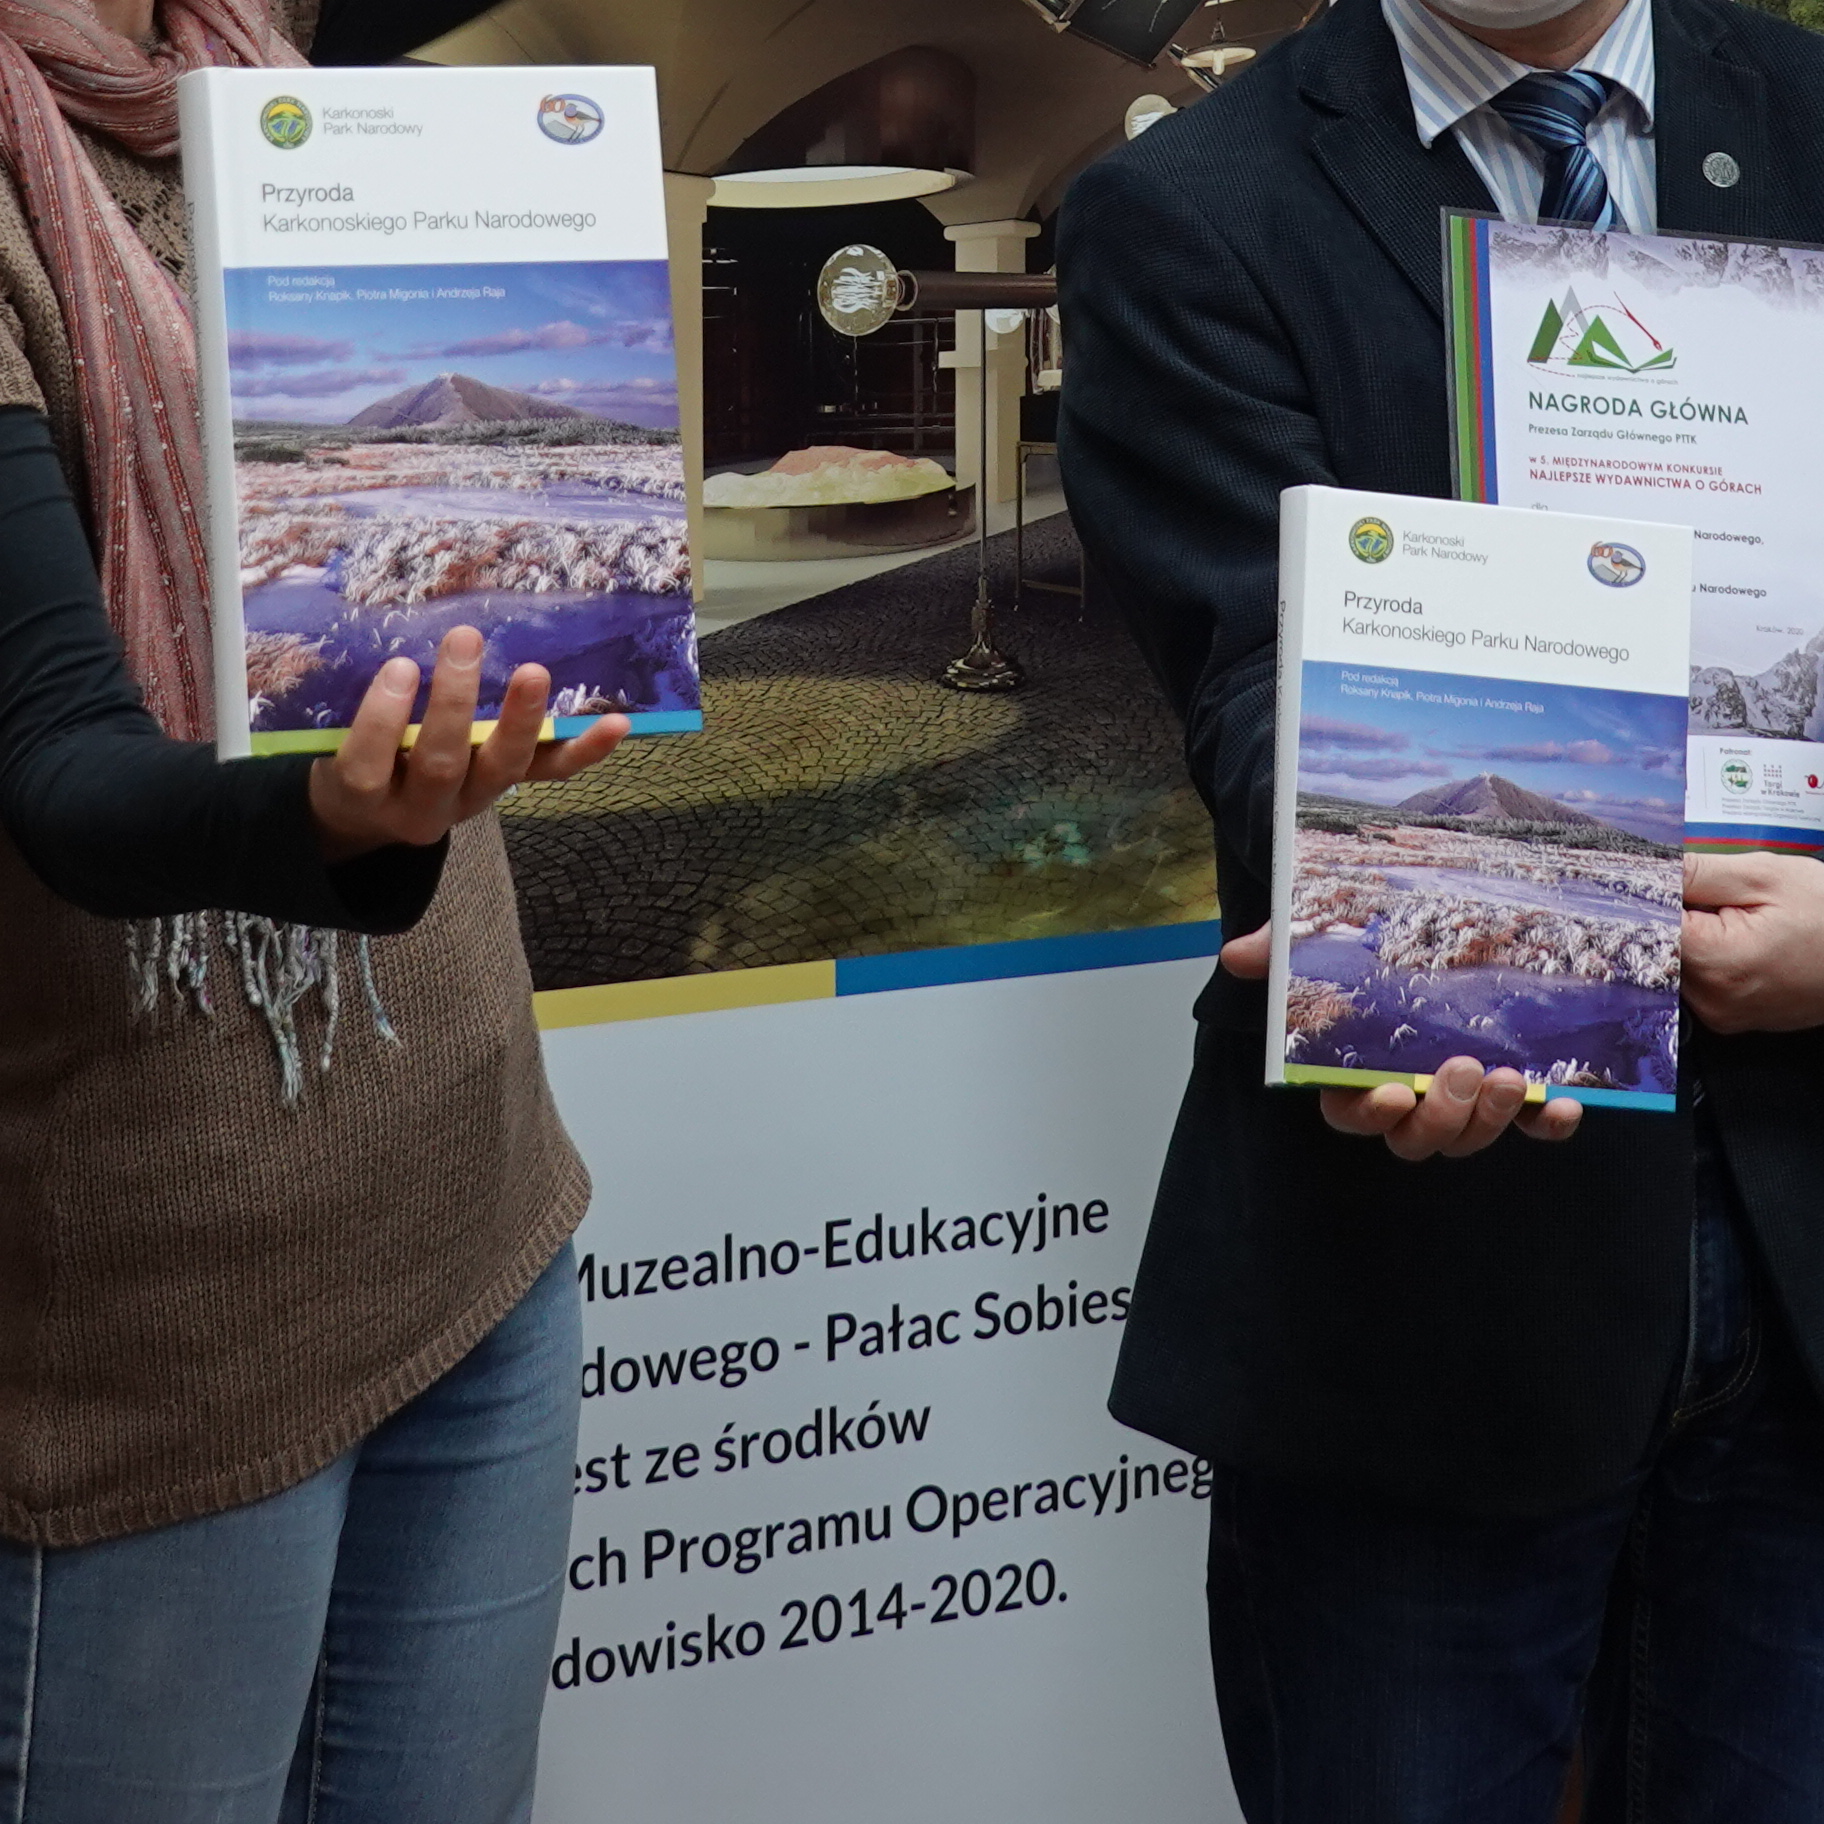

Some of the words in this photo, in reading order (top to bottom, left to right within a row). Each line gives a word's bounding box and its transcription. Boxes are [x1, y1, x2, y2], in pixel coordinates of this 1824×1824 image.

[323, 107, 394, 119] Karkonoski
[324, 122, 353, 135] Park
[357, 122, 423, 137] Narodowy
[262, 183, 354, 207] Przyroda
[264, 213, 407, 235] Karkonoskiego
[414, 211, 468, 230] Parku
[475, 210, 596, 232] Narodowego
[267, 276, 289, 286] Pod
[1529, 391, 1642, 417] NAGRODA
[1650, 397, 1748, 425] GŁÓWNA
[1529, 424, 1568, 436] Prezesa
[1571, 427, 1613, 440] Zarządu
[1617, 430, 1672, 444] Głównego
[1676, 434, 1696, 444] PTTK
[1553, 457, 1663, 471] MIĘDZYNARODOWYM
[1667, 464, 1722, 476] KONKURSIE
[1530, 469, 1591, 483] NAJLEPSZE
[1595, 474, 1691, 489] WYDAWNICTWA
[1695, 480, 1705, 490] O
[1709, 479, 1761, 494] GÓRACH
[1403, 530, 1464, 547] Karkonoski
[1694, 530, 1764, 545] Narodowego,
[1403, 544, 1427, 556] Park
[1431, 547, 1488, 565] Narodowy
[1700, 583, 1767, 599] Narodowego
[1344, 591, 1423, 615] Przyroda
[1343, 617, 1465, 647] Karkonoskiego
[1472, 630, 1518, 650] Parku
[1525, 635, 1629, 664] Narodowego
[1342, 671, 1359, 681] Pod
[1416, 692, 1442, 703] Piotra
[1485, 699, 1522, 712] Andrzeja
[1525, 702, 1544, 714] Raja
[827, 1303, 961, 1362] Pałac
[645, 1443, 700, 1485] ze
[714, 1400, 931, 1473] środków
[644, 1505, 891, 1580] Programu
[780, 1558, 1067, 1651] 2014-2020.
